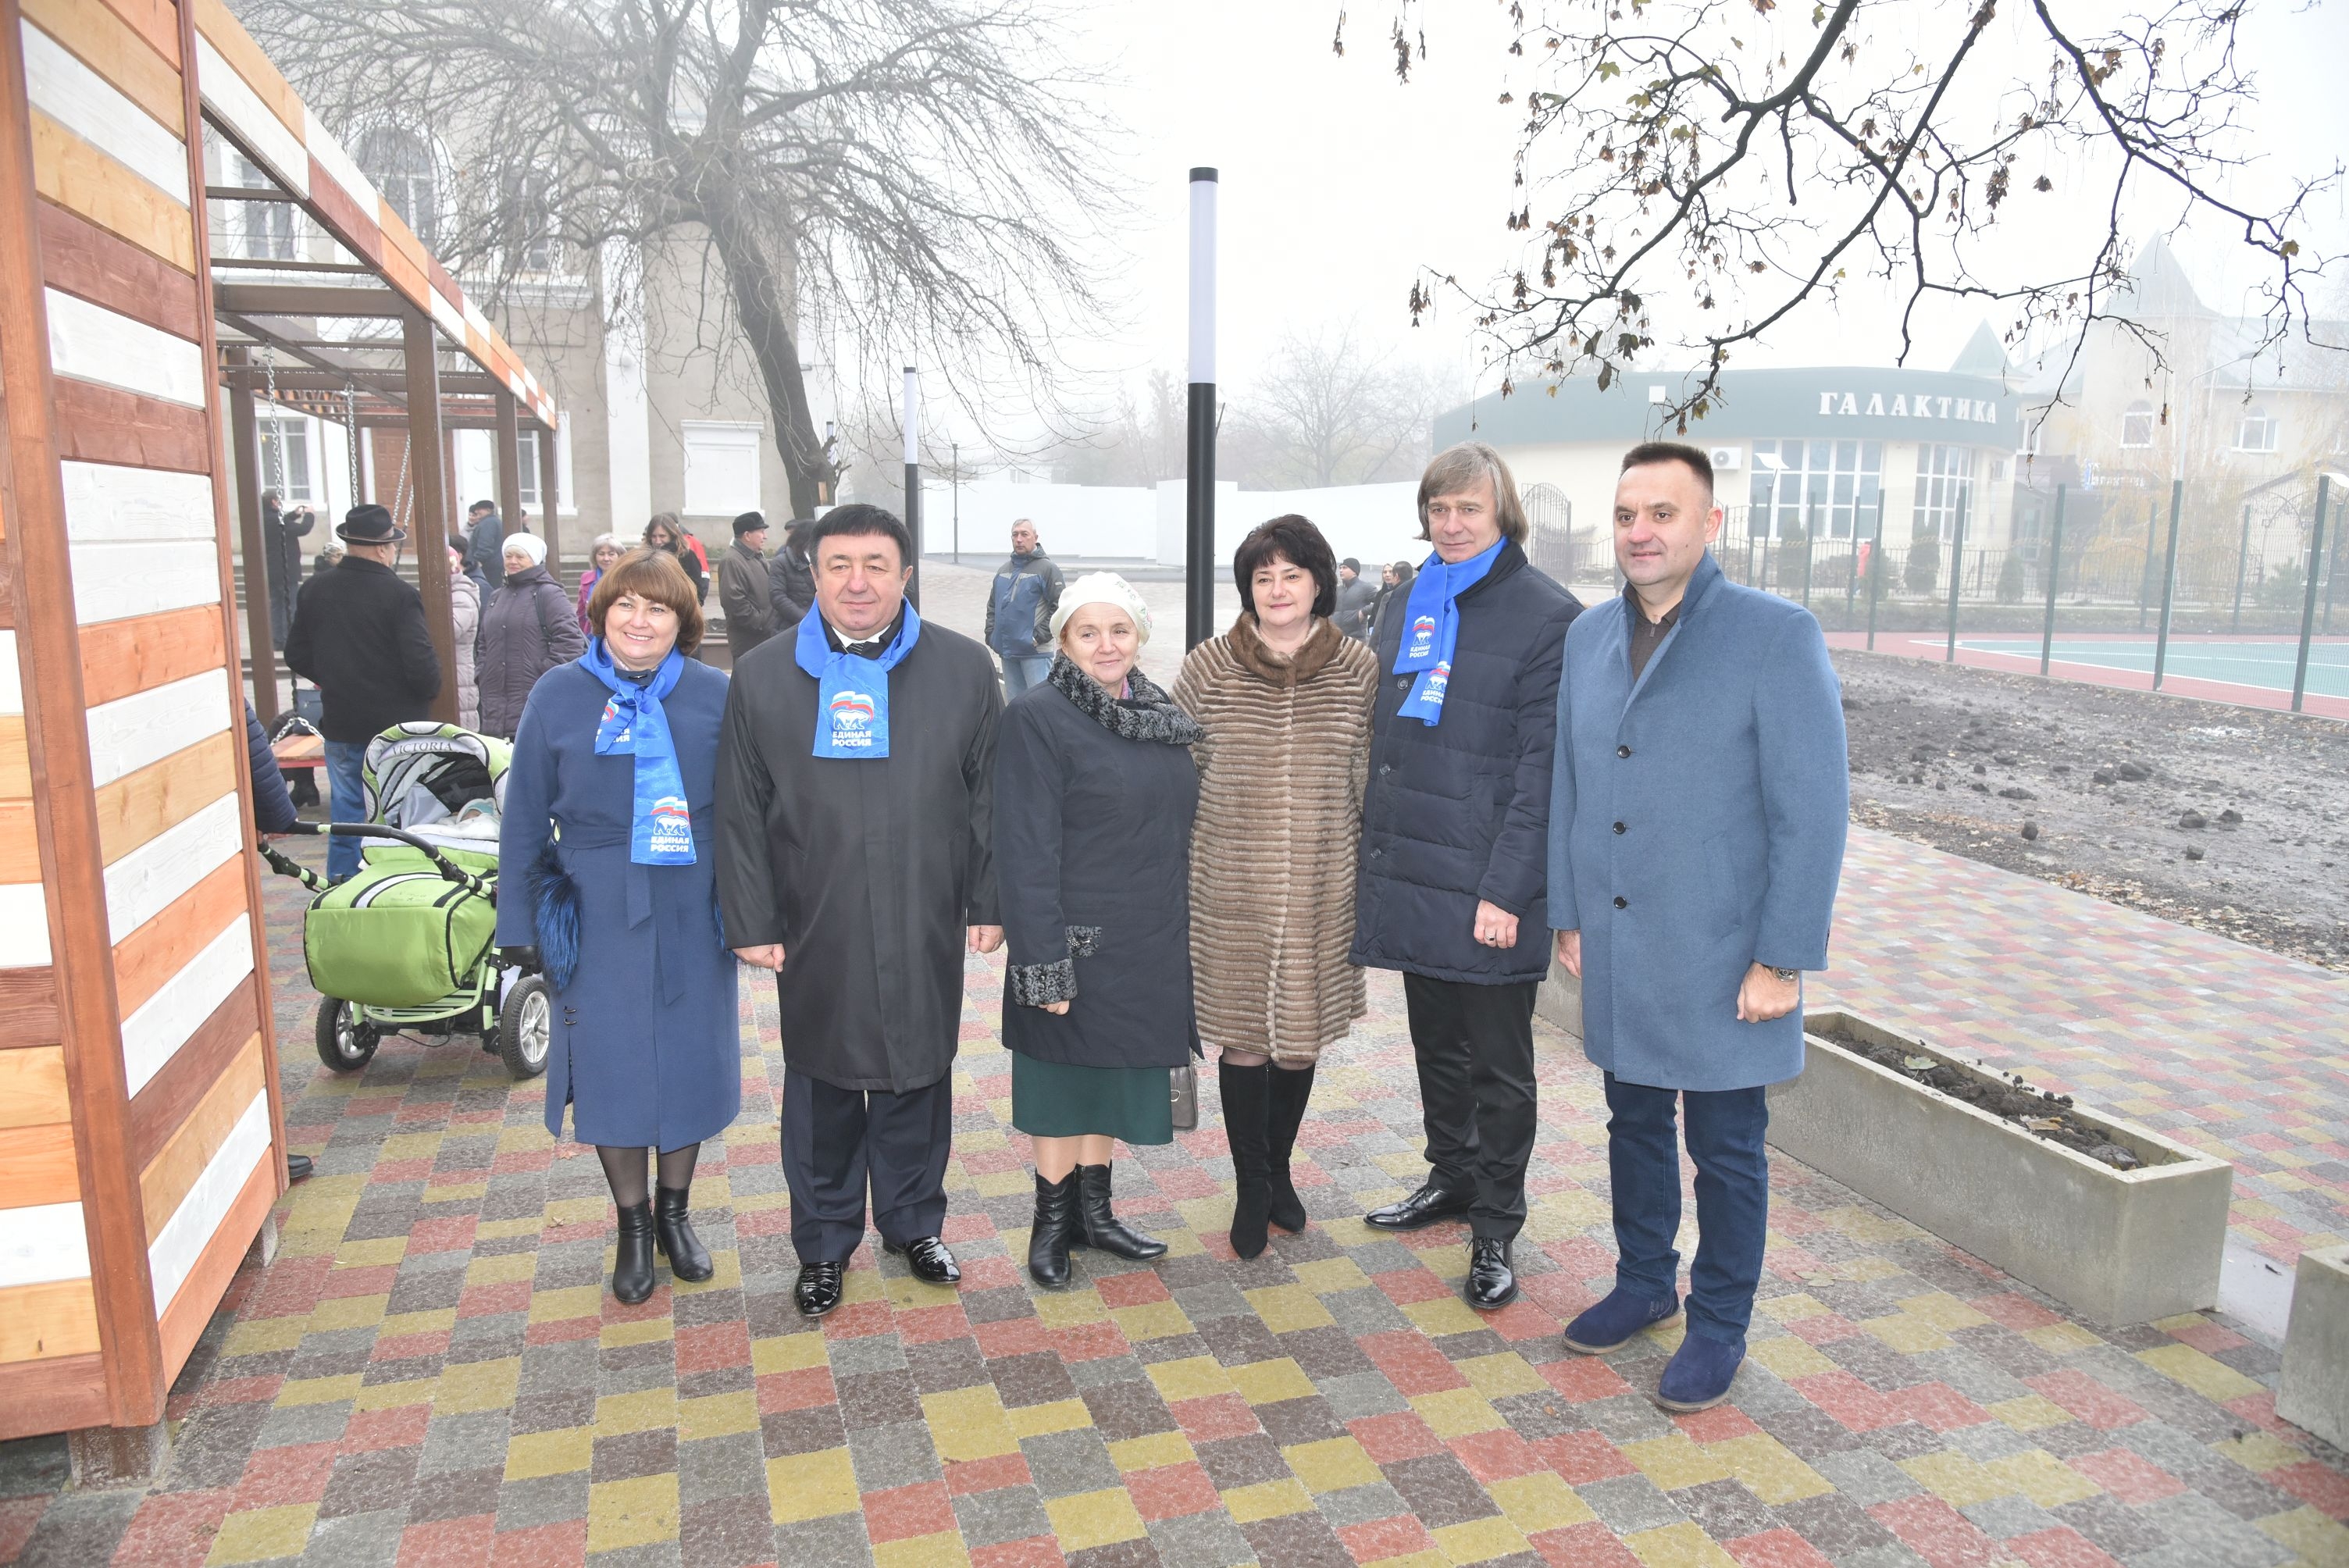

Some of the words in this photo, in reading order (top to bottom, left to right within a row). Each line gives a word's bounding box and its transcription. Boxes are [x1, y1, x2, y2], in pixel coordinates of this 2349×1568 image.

[1818, 392, 1997, 424] ГАЛАКТИКА
[1422, 690, 1444, 699] ЕДИНА
[1420, 695, 1443, 706] РОССИ
[832, 730, 872, 739] ЕДИНАЯ
[832, 738, 872, 747] РОССИЯ
[393, 742, 453, 755] VICTORIA
[651, 836, 690, 844] ЕДИНАЯ
[651, 843, 689, 853] РОССИЯ
